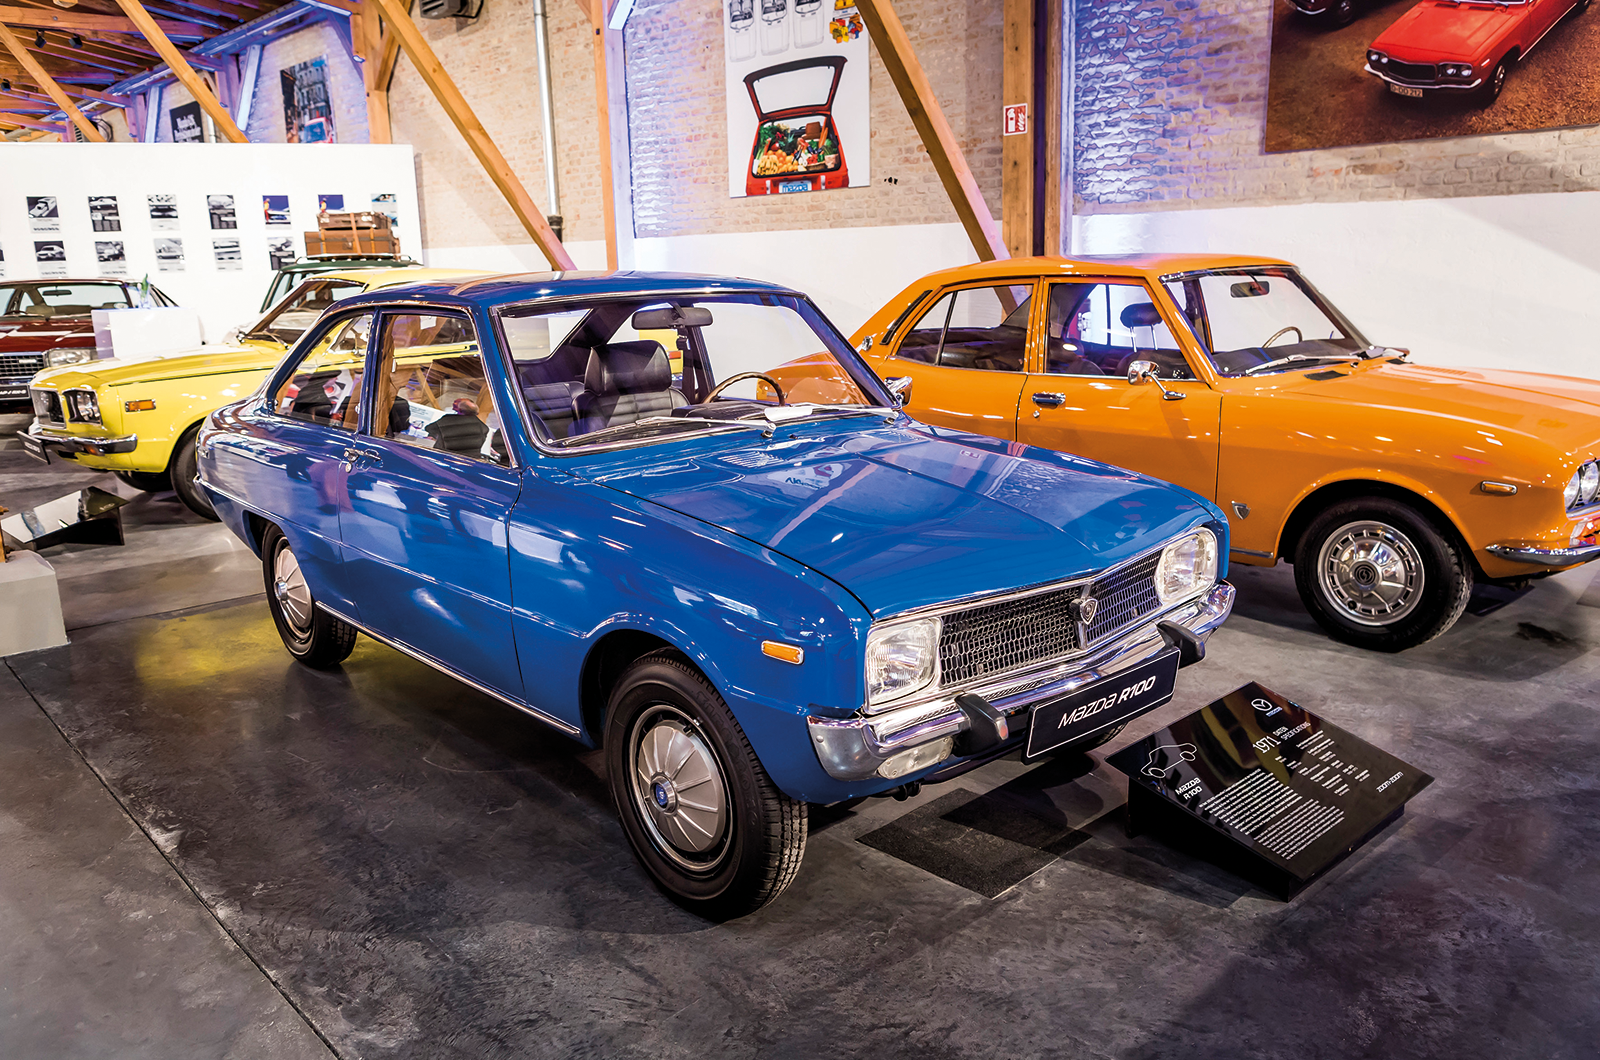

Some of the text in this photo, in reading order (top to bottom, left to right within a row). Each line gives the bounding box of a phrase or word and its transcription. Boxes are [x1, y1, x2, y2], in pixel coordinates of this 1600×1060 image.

[1057, 675, 1157, 730] Mazda R100
[1252, 735, 1281, 754] 1971
